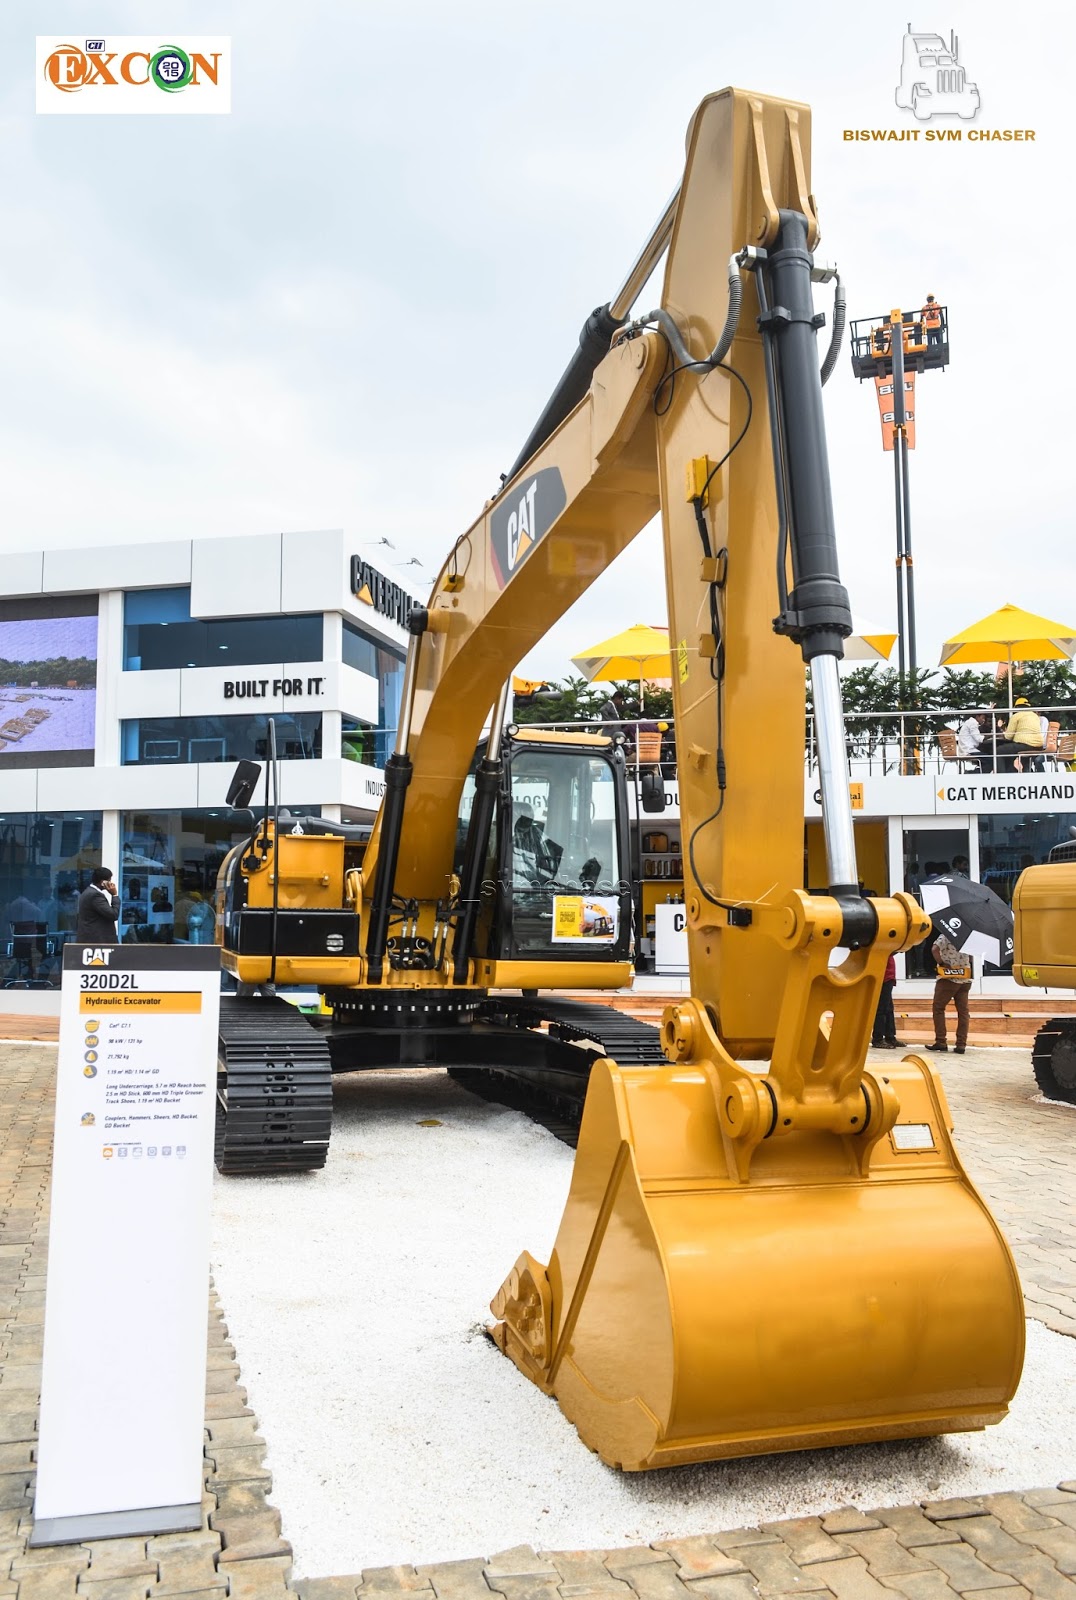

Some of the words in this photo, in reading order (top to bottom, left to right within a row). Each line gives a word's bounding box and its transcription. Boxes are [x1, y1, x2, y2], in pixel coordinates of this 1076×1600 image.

[507, 479, 537, 571] CAT
[224, 680, 269, 699] BUILT
[273, 679, 303, 697] FOR
[947, 787, 977, 801] CAT
[982, 785, 1075, 801] MERCHAND
[82, 948, 113, 966] CAT
[80, 974, 138, 989] 320D2L
[85, 997, 122, 1006] Hydraulic
[124, 997, 161, 1005] Excavator
